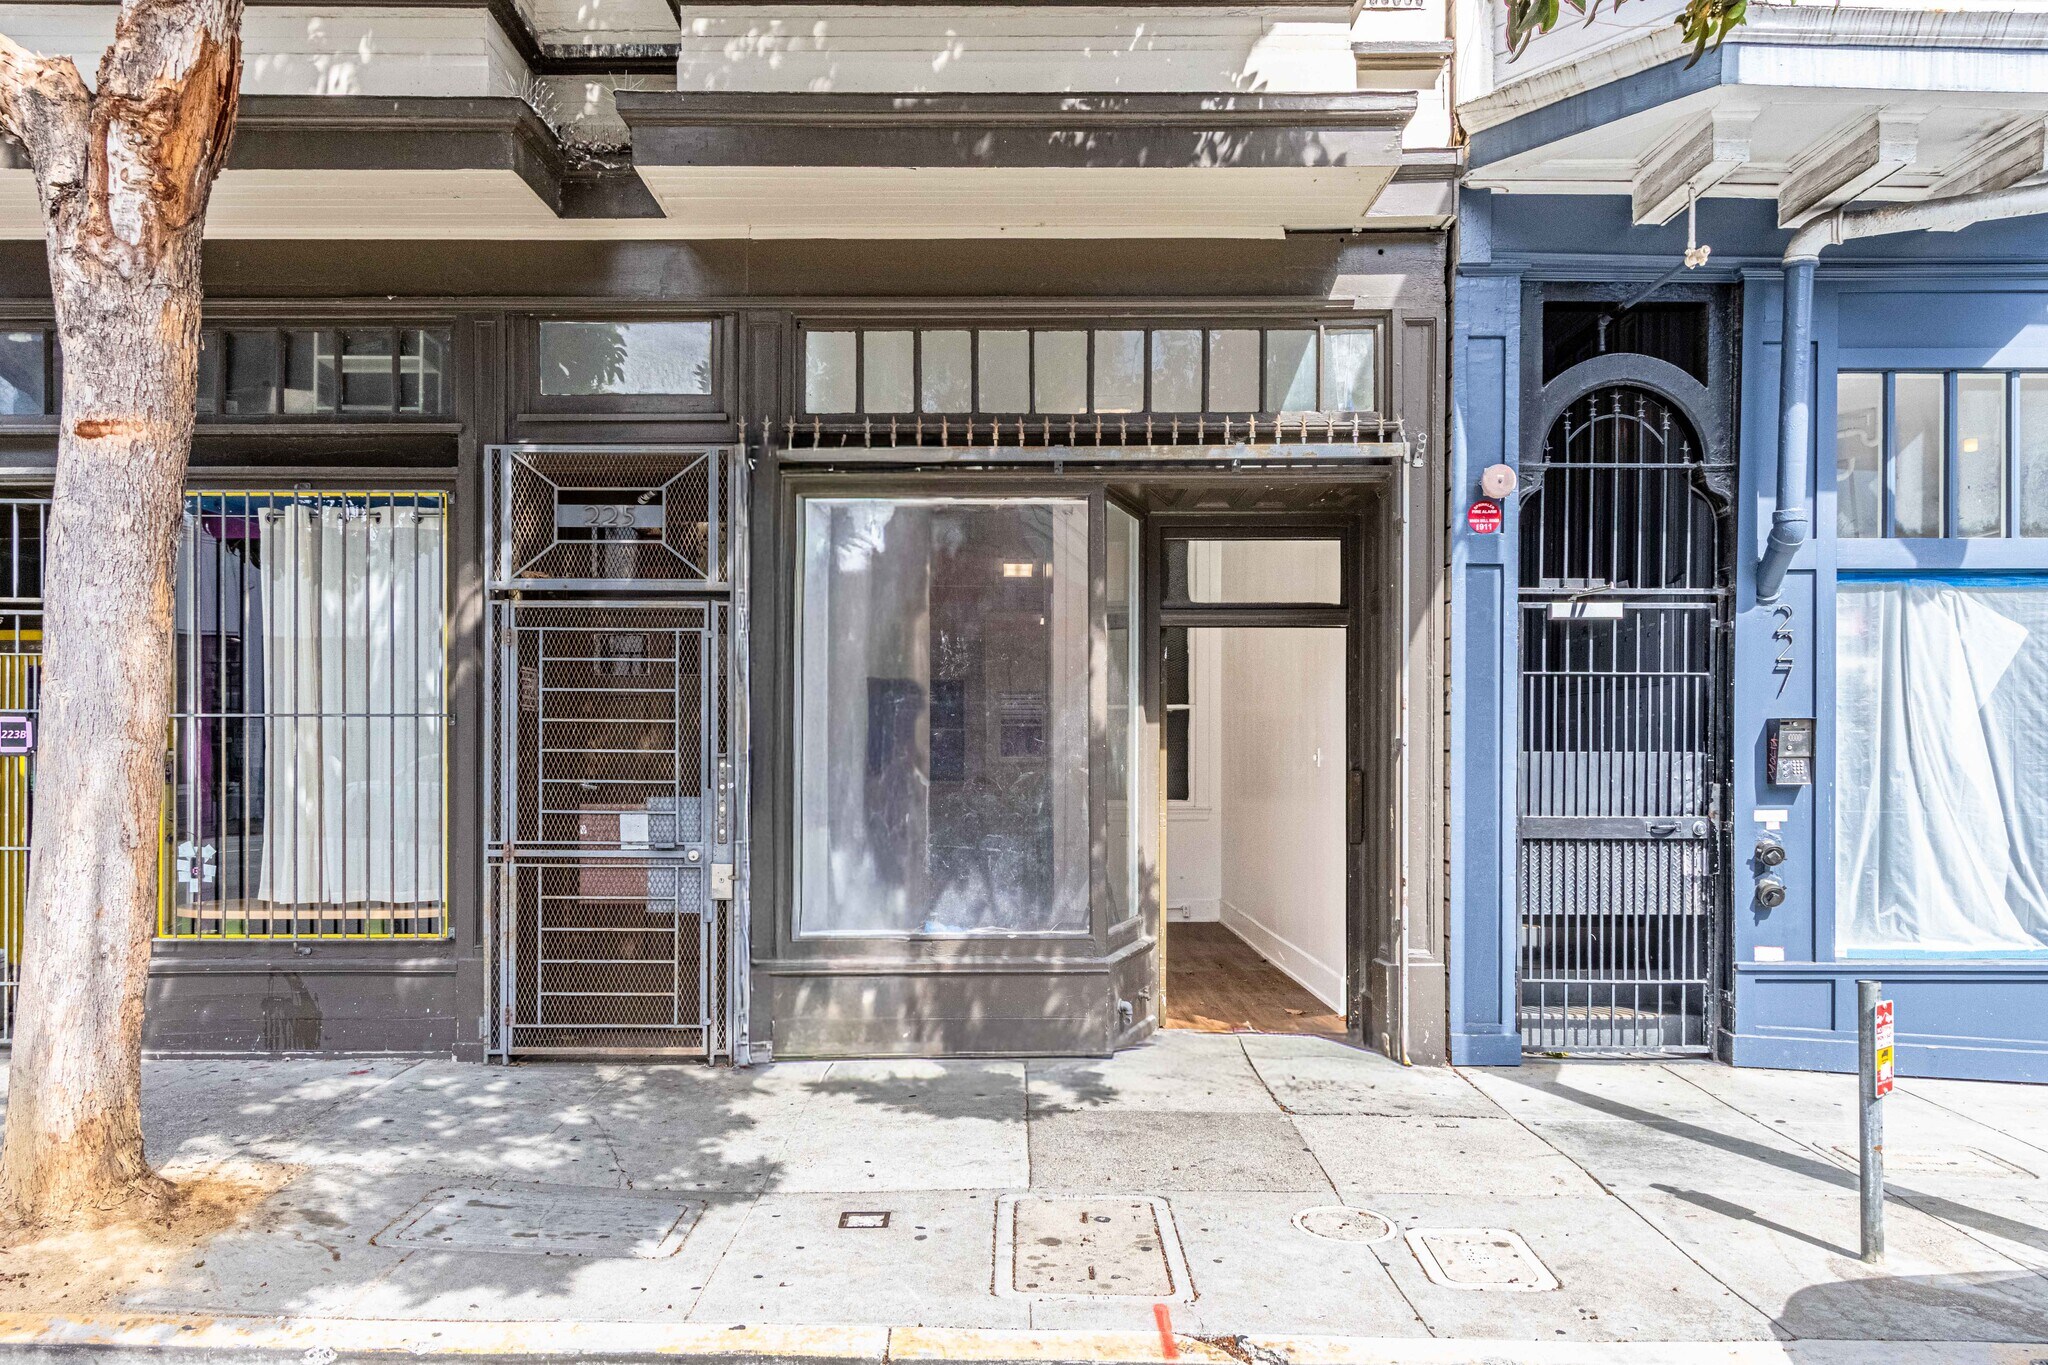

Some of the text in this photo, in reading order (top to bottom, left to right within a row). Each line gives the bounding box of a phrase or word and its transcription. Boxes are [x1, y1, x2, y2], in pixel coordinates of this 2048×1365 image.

[584, 505, 635, 527] 225
[1774, 603, 1794, 698] 227
[1, 730, 27, 739] 223B
